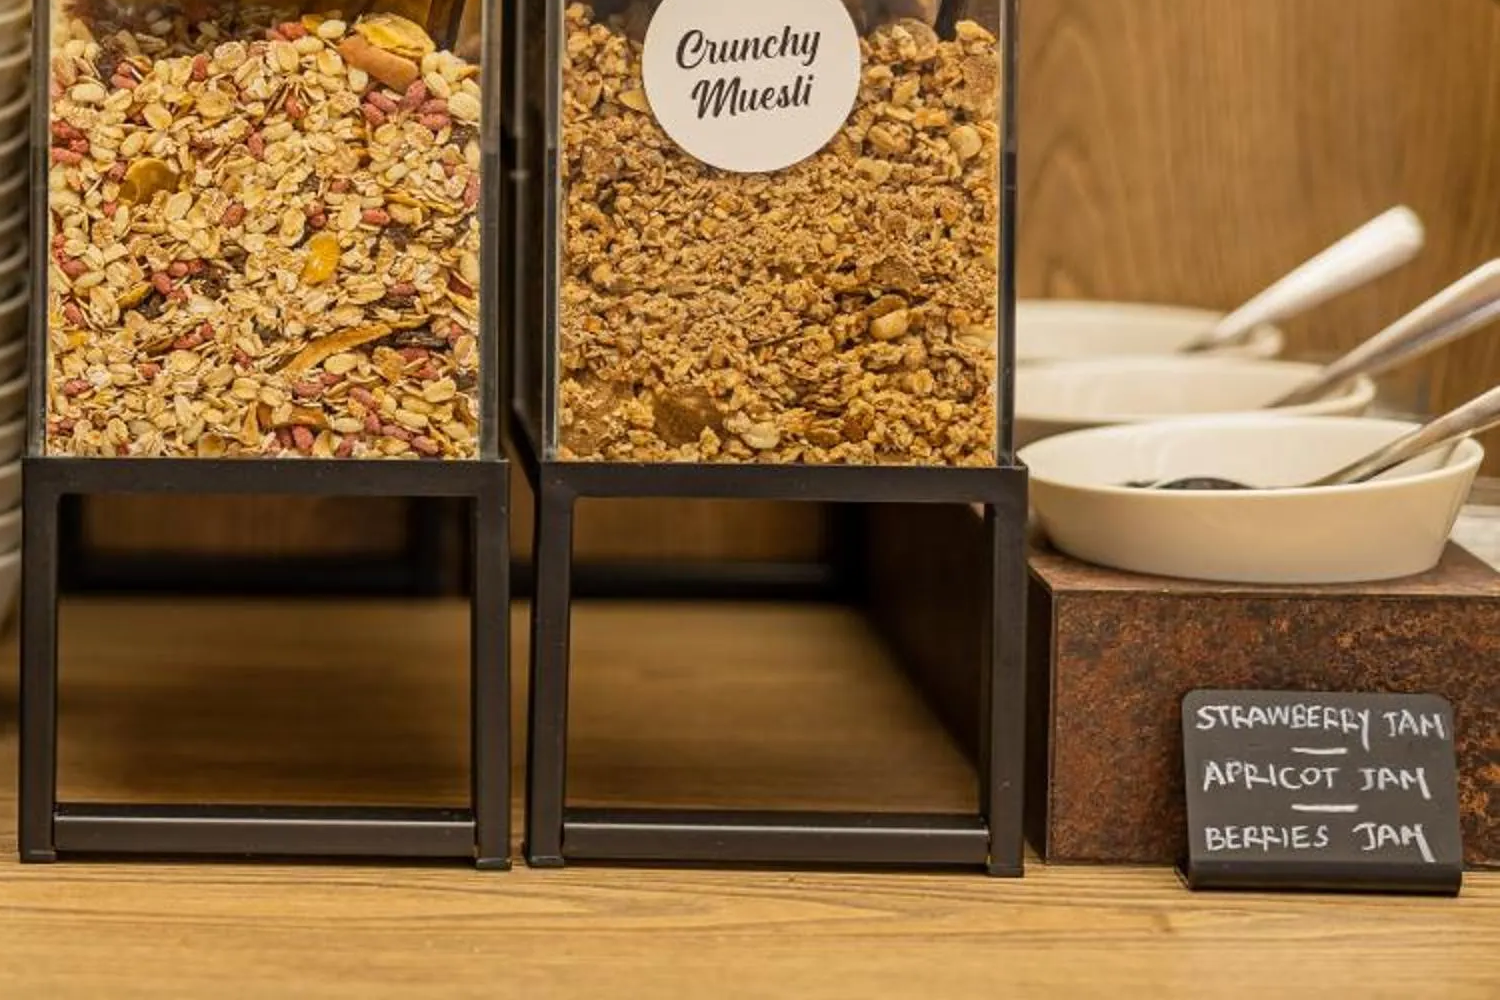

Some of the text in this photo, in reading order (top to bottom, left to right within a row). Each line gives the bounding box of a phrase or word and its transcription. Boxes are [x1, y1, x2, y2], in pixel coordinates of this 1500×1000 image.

[676, 25, 821, 70] Crunchy
[691, 74, 814, 120] Muesli
[1196, 704, 1445, 751] STRAWBERRY JAM
[1203, 761, 1432, 800] APRICOT JAM
[1205, 822, 1437, 863] BERRIES JAM
